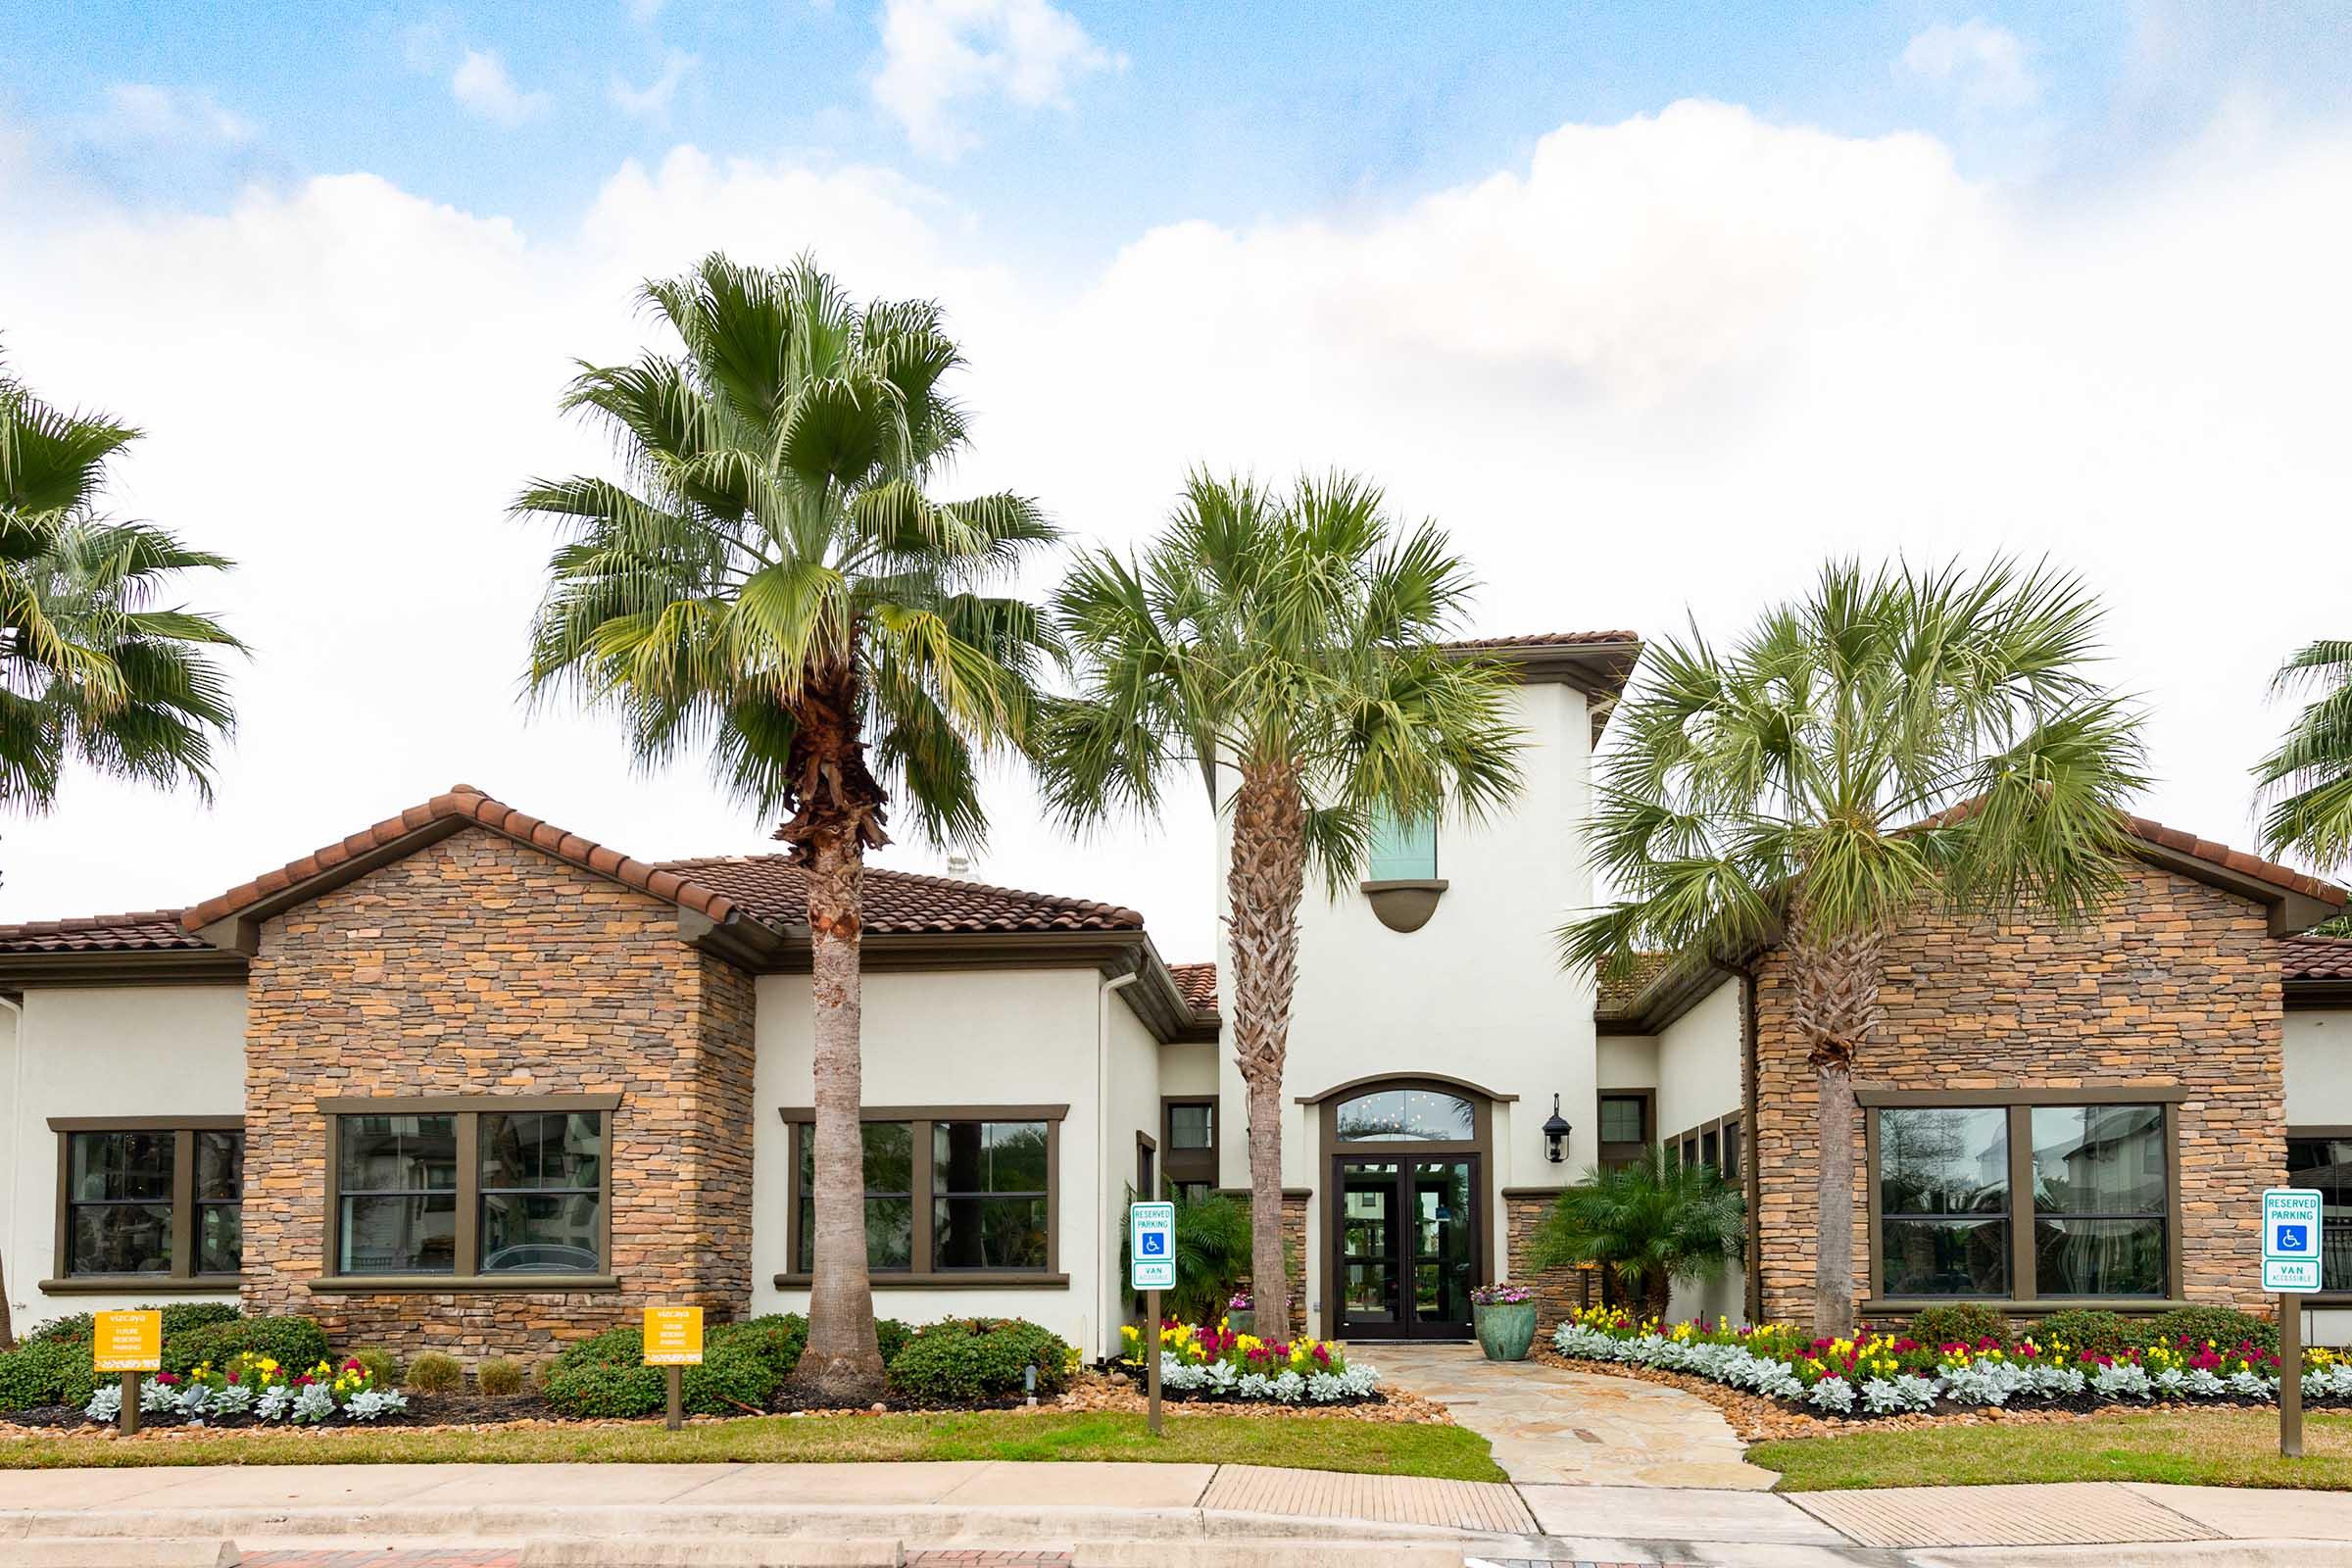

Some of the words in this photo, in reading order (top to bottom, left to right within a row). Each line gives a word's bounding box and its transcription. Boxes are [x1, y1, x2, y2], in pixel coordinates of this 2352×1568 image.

[2269, 1199, 2317, 1208] RESERVED
[2272, 1210, 2314, 1220] PARKING
[1138, 1220, 1168, 1229] PARKING
[2273, 1274, 2312, 1283] ACCESSIBLE
